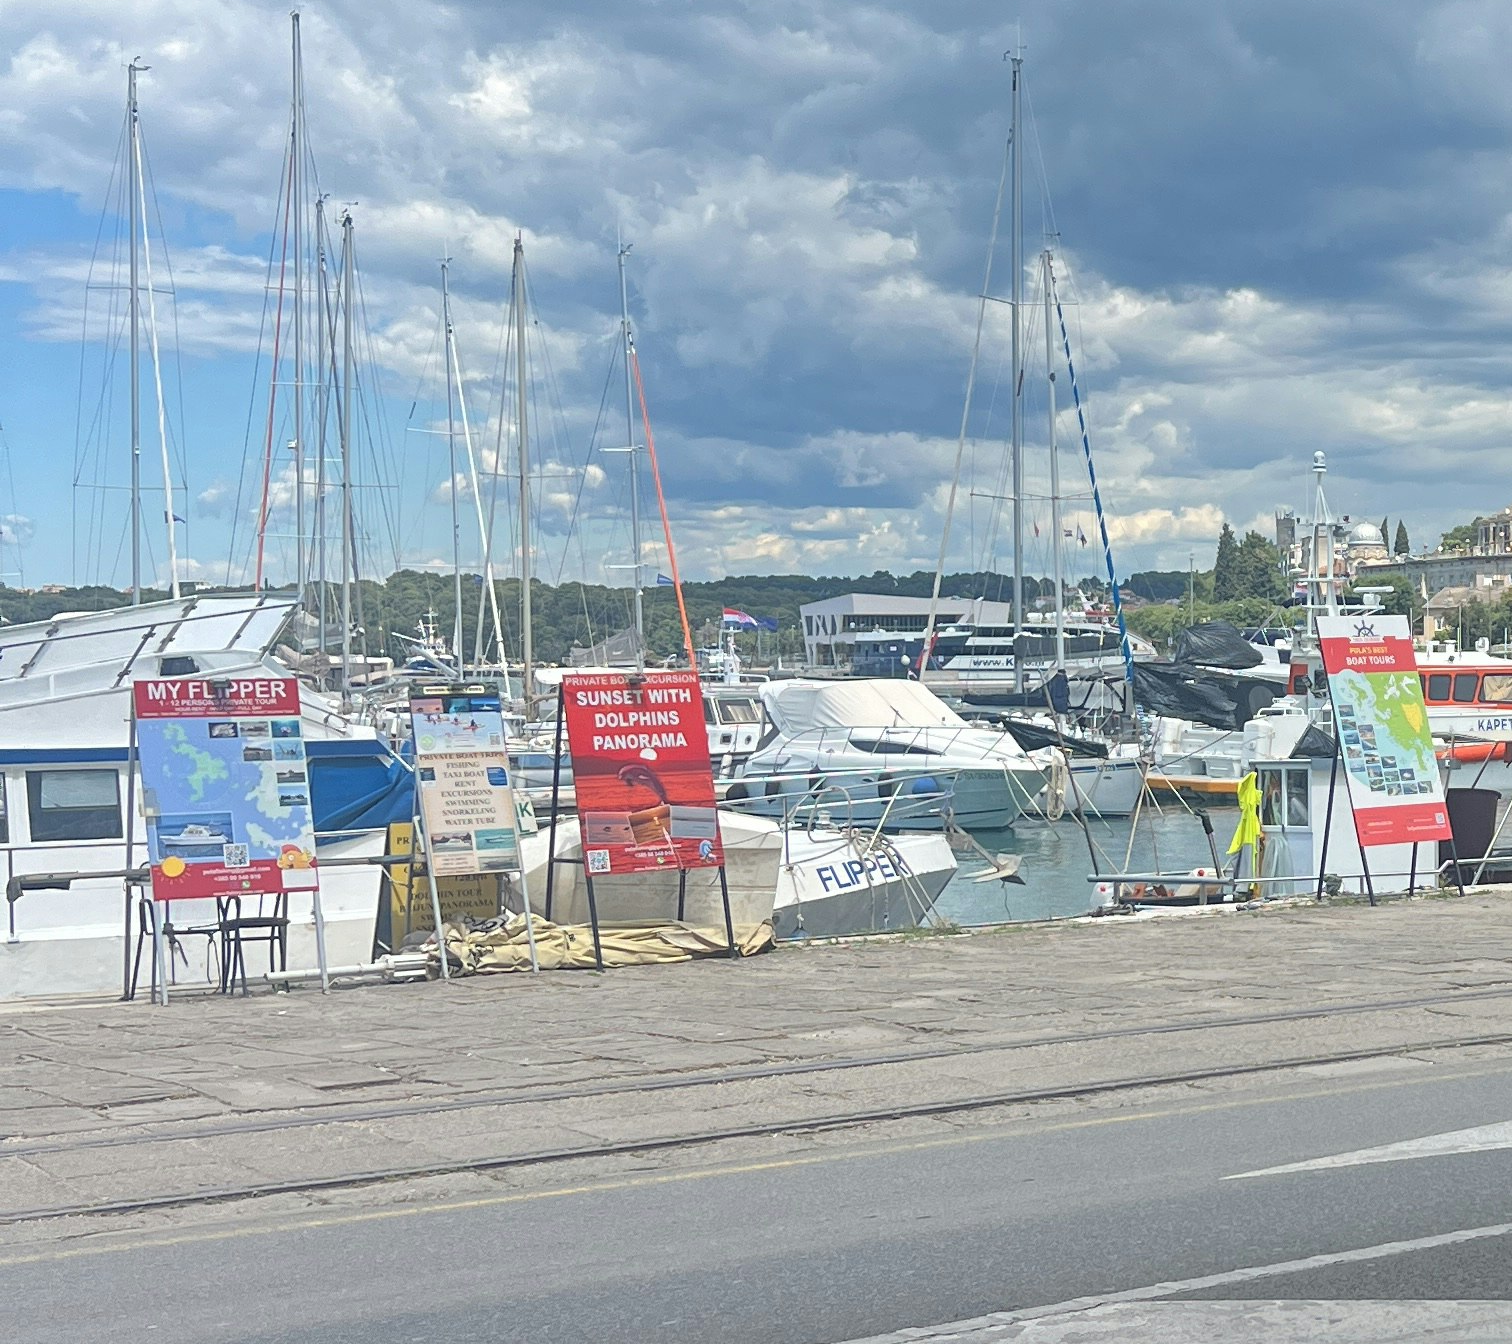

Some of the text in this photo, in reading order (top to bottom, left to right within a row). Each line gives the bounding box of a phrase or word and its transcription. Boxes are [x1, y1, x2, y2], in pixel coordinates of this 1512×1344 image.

[1346, 655, 1395, 665] BOAT TOURS
[565, 676, 608, 686] PRIVATE
[644, 674, 697, 685] XCURSION
[147, 682, 181, 700] MY
[576, 688, 692, 706] SUNSET WITH
[594, 711, 680, 728] DOLPHINS
[593, 732, 688, 751] PANORAMA
[419, 750, 504, 761] PRIVATE BOAT TRIPS
[441, 789, 493, 798] EXCURSIONS
[445, 798, 491, 806] SWIMMING
[442, 807, 496, 816] SNORKELING
[445, 817, 473, 826] WATER
[816, 854, 909, 892] FLIPPER
